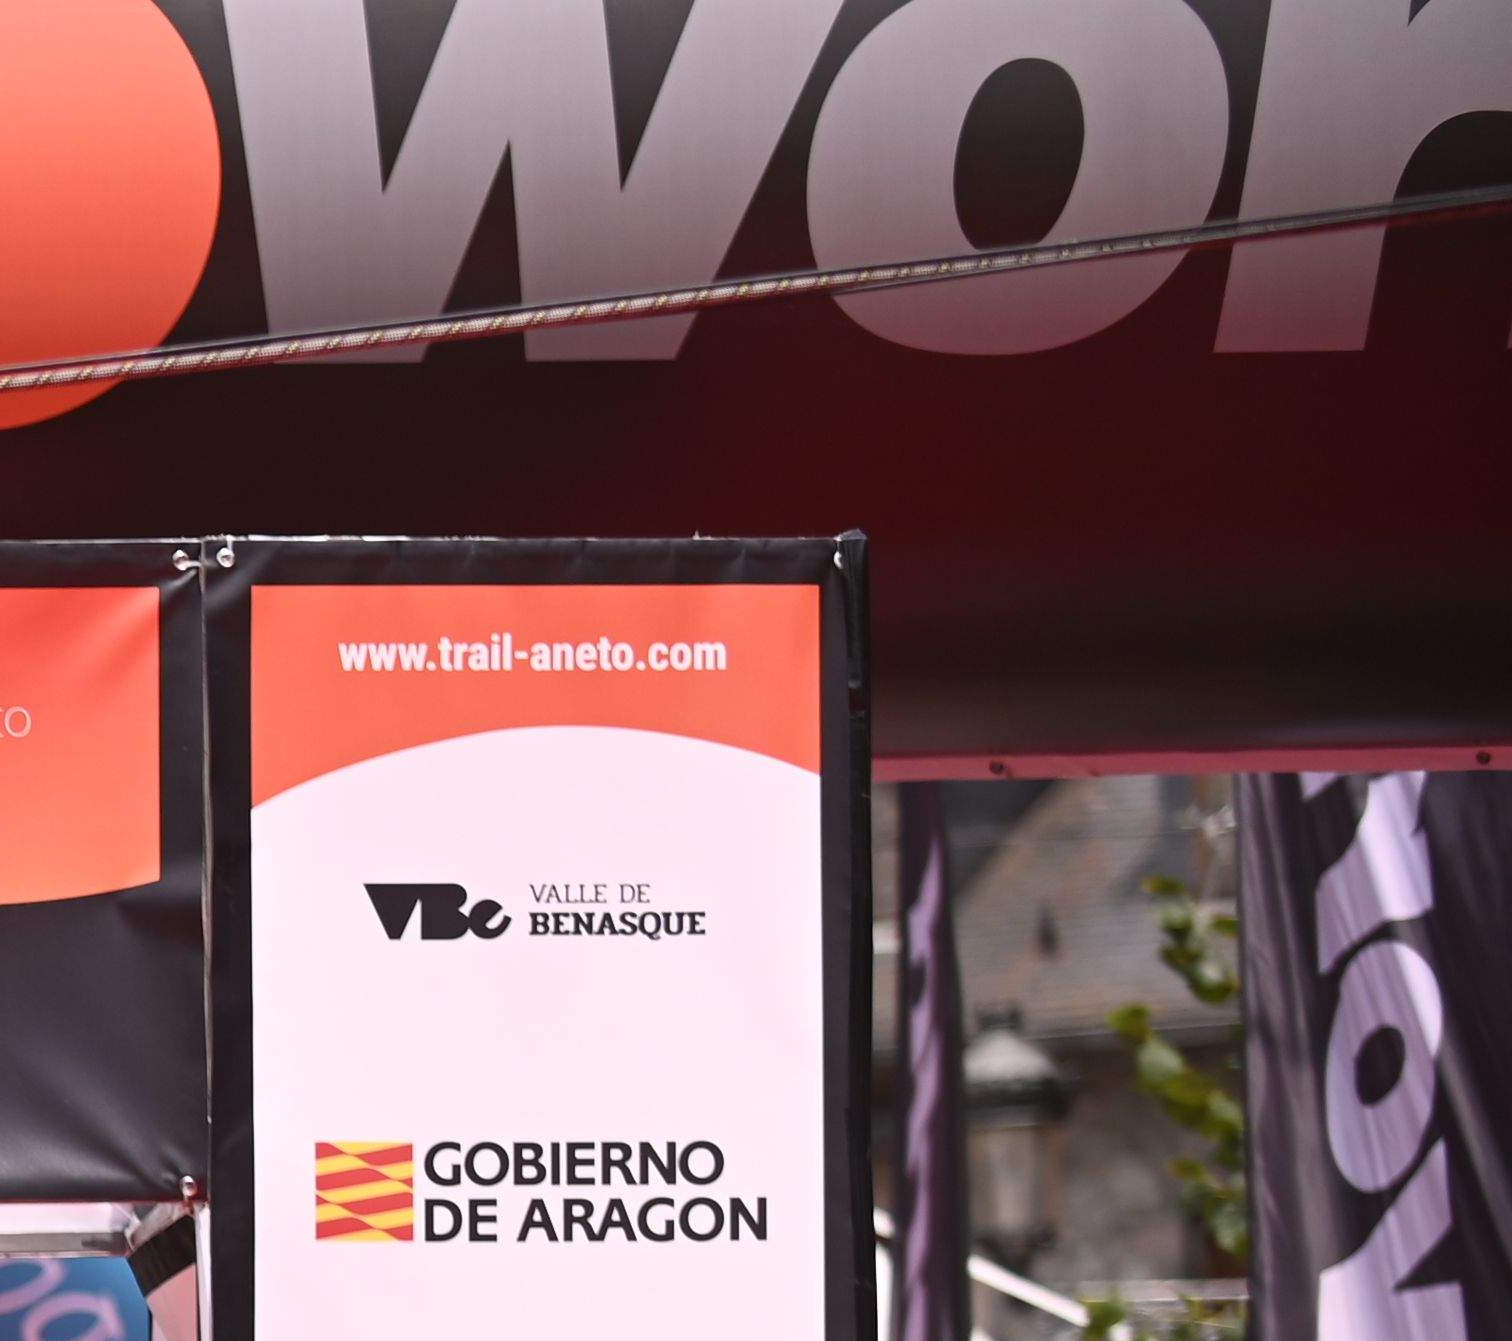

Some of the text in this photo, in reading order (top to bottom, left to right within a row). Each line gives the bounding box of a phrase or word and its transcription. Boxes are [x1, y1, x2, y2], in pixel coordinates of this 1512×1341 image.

[337, 632, 728, 672] www.trail-aneto.com
[529, 883, 651, 904] VALLE DE
[529, 911, 706, 940] BENASQUE
[424, 1140, 725, 1187] GOBIERNO
[424, 1196, 768, 1243] DE ARAGON
